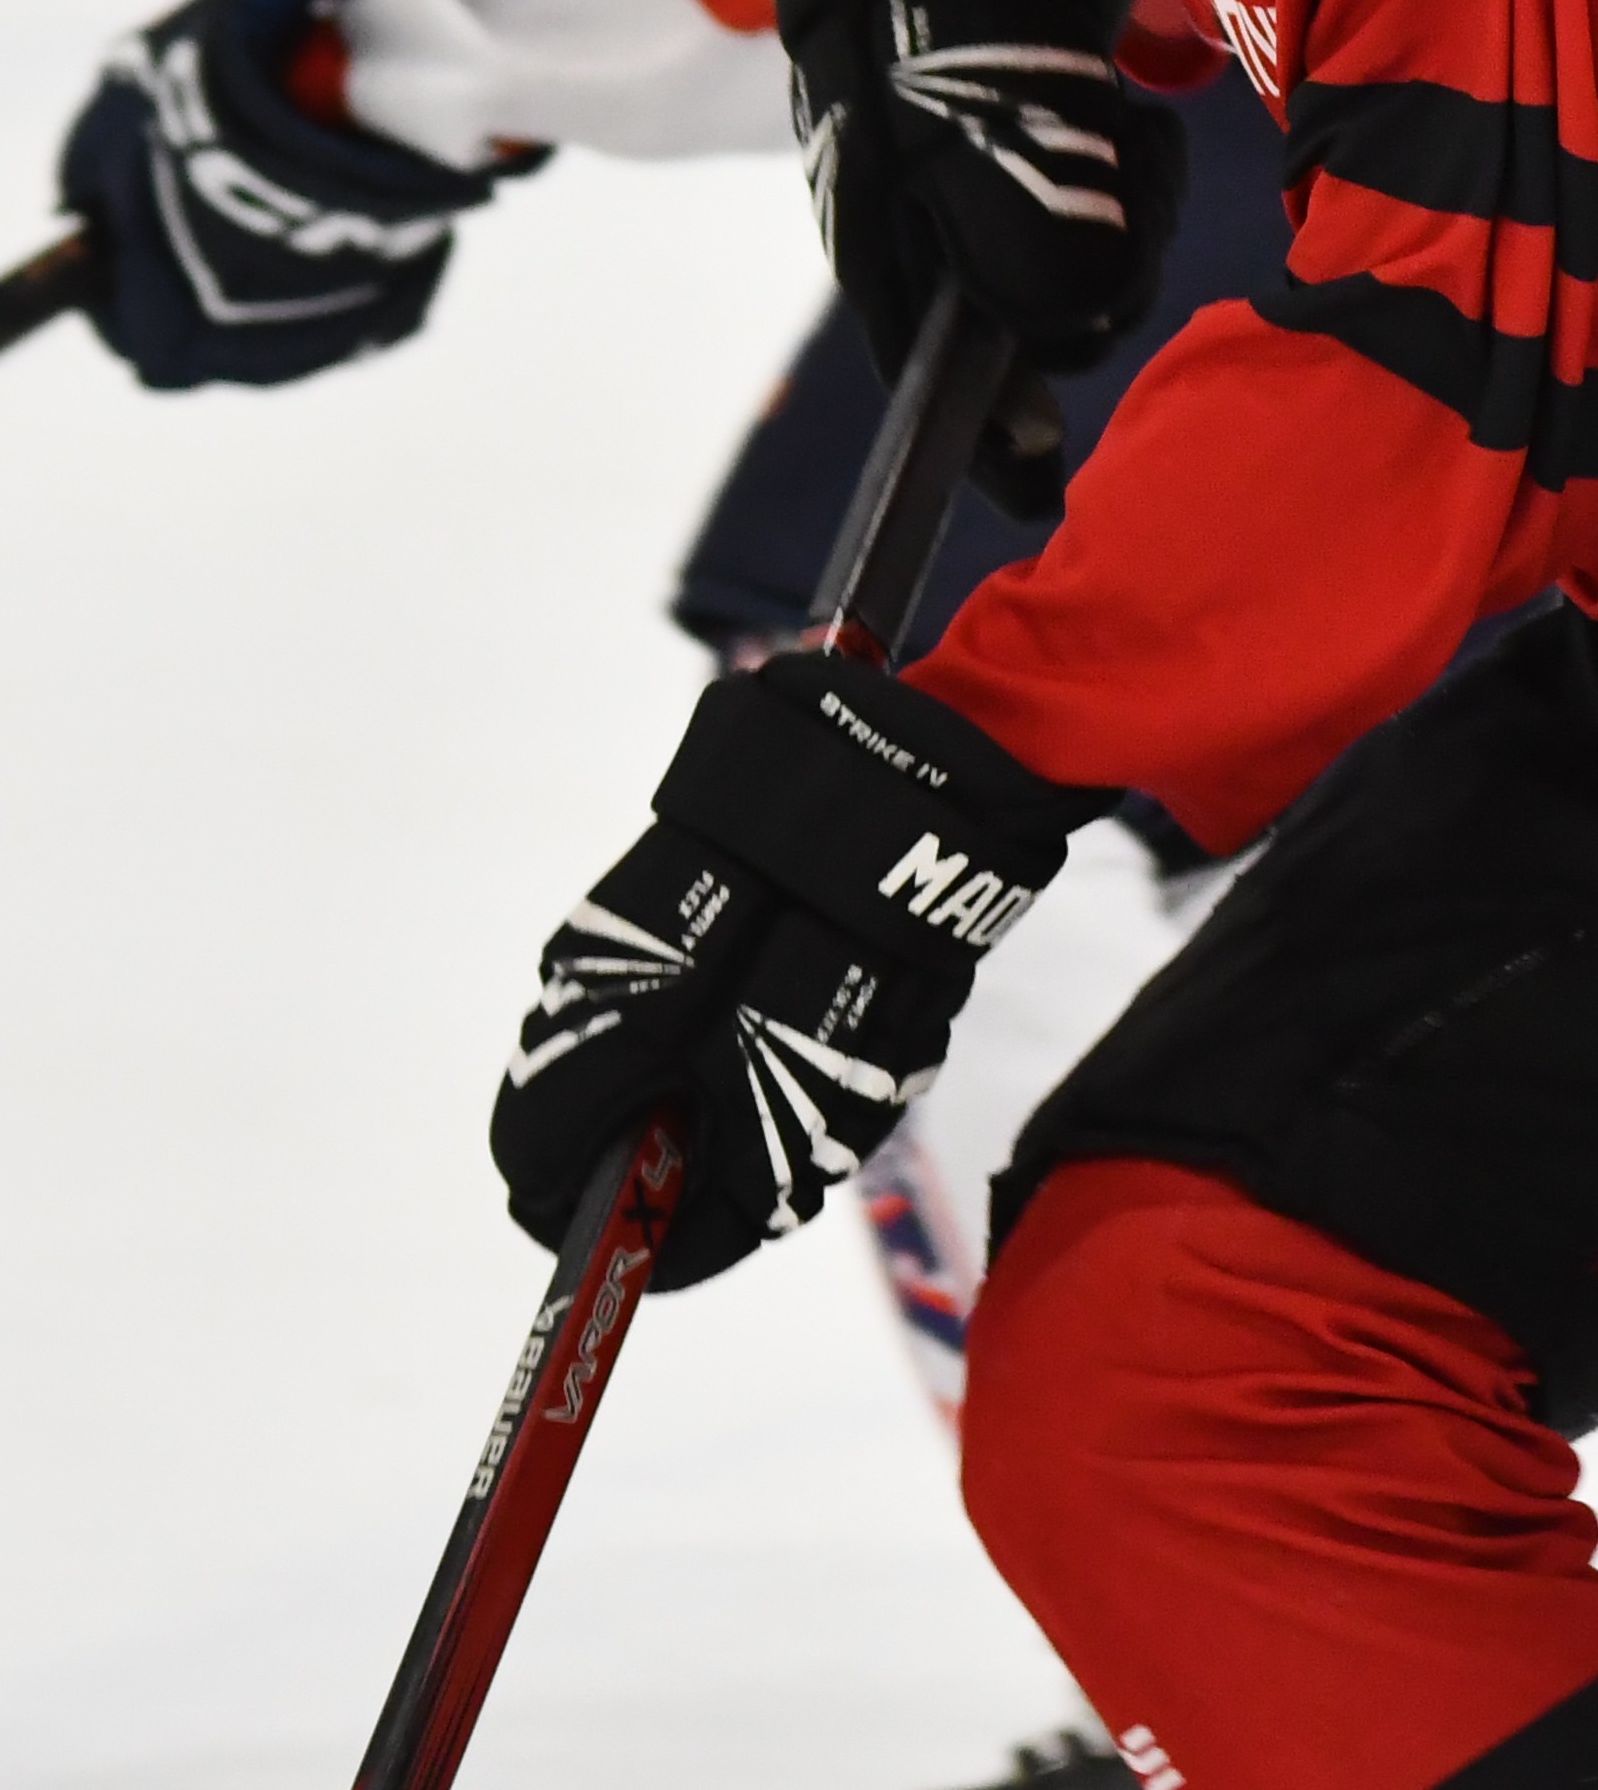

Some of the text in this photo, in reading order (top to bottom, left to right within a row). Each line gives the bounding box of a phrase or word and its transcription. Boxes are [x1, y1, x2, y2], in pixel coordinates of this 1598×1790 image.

[819, 690, 949, 788] STRIKE IV
[877, 831, 1038, 948] MAD
[544, 1245, 652, 1424] VAPOR
